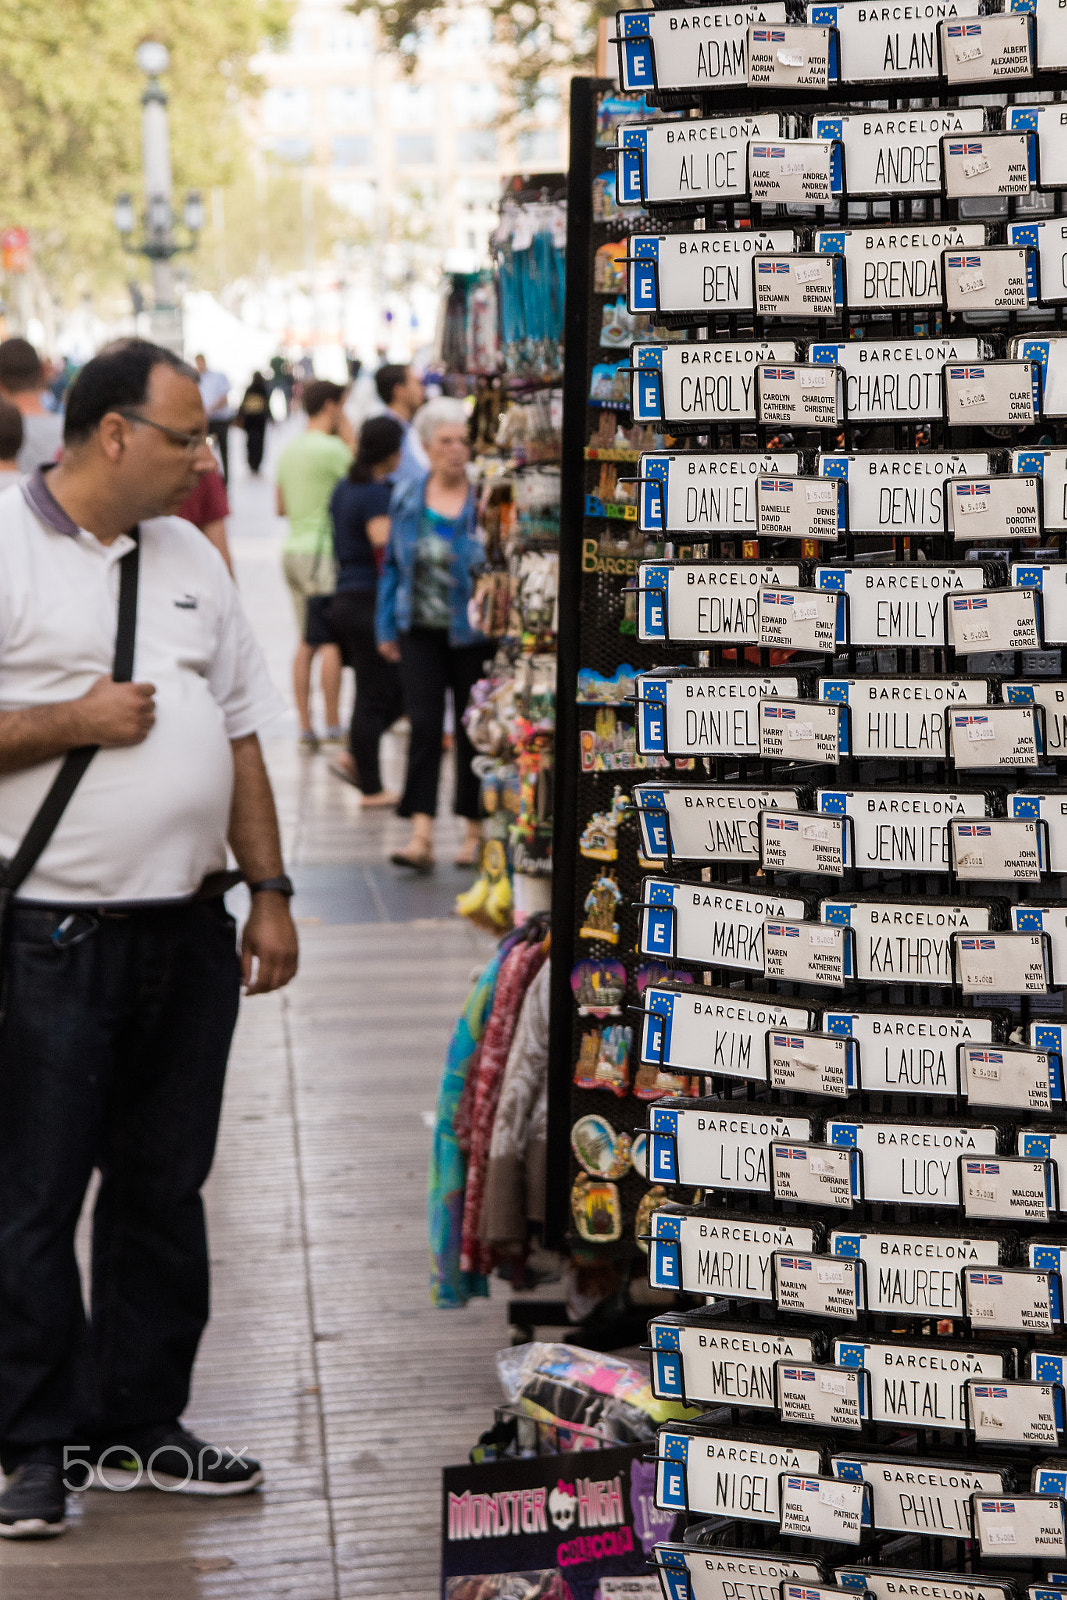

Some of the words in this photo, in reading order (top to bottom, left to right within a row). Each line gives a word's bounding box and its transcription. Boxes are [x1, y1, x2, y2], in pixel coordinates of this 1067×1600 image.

[858, 4, 958, 22] BARCELONA
[669, 12, 767, 30] BARCELONA
[883, 32, 934, 71] ALAN
[1003, 45, 1027, 54] ALBERT
[697, 39, 746, 78] ADAM
[751, 54, 773, 62] AARON
[807, 57, 826, 65] AITOR
[991, 56, 1028, 65] ALEXANDER
[634, 56, 646, 76] E
[751, 64, 775, 73] ADRIAN
[809, 66, 826, 74] ALAN
[993, 66, 1029, 75] ALEXANDRA
[751, 74, 770, 82] ADAM
[797, 76, 826, 84] ALASTAIR
[863, 118, 963, 135] BARCELONA
[667, 124, 761, 143] BARCELONA
[875, 145, 941, 184] ANDRE
[1008, 164, 1027, 172] ANITA
[679, 150, 738, 190] ALICE
[997, 184, 1028, 192] ANTHONY
[679, 239, 775, 254] BARCELONA
[865, 234, 965, 249] BARCELONA
[703, 265, 739, 302] BEN
[864, 260, 942, 299] BRENDA
[1008, 278, 1024, 286] CARL
[758, 284, 771, 292] BEN
[805, 285, 832, 293] BEVERLY
[1004, 287, 1025, 296] CAROL
[758, 294, 790, 302] BENJAMIN
[802, 295, 832, 303] BRENDAN
[994, 297, 1025, 306] CAROLINE
[759, 304, 777, 312] BETTY
[813, 305, 833, 313] BRIAN
[681, 350, 776, 364] BARCELONA
[859, 347, 958, 362] BARCELONA
[645, 387, 656, 407] E
[680, 375, 756, 412] CAROLY
[763, 393, 790, 402] CAROLYN
[801, 395, 835, 404] CHARLOTTE
[763, 403, 796, 412] CATHERINE
[804, 405, 835, 414] CHRISTINE
[763, 412, 791, 421] CHARLES
[814, 415, 836, 424] CLAIRE
[688, 461, 779, 475] BARCELONA
[869, 462, 967, 475] BARCELONA
[1025, 479, 1034, 487] 10
[686, 486, 755, 523] DANIEL
[761, 505, 790, 514] DANIELLE
[879, 487, 942, 524] DENIS
[816, 508, 836, 516] DENIS
[1016, 506, 1036, 514] DONA
[761, 514, 780, 522] DAVID
[813, 517, 836, 525] DENISE
[1005, 516, 1037, 524] DOROTHY
[761, 524, 792, 532] DEBORAH
[808, 526, 836, 536] DOMINIC
[1010, 526, 1037, 534] DOREEN
[687, 572, 780, 585] BARCELONA
[865, 576, 964, 589] BARCELONA
[876, 601, 939, 638] EMILY
[686, 685, 778, 698] BARCELONA
[869, 687, 967, 700] BARCELONA
[650, 721, 661, 741] E
[686, 710, 757, 746] DANIEL
[763, 728, 784, 737] HARRY
[763, 737, 783, 746] HELEN
[814, 732, 836, 742] HILARY
[1017, 736, 1034, 744] JACK
[763, 747, 784, 755] HENRY
[817, 743, 836, 751] HOLLY
[1012, 746, 1034, 754] JACKIE
[999, 756, 1036, 764] JACQUELINE
[684, 796, 779, 808] BARCELONA
[867, 800, 966, 814] BARCELONA
[705, 820, 760, 853] JAMES
[692, 893, 786, 917] BARCELONA
[870, 910, 969, 927] BARCELONA
[654, 923, 665, 943] E
[712, 921, 762, 962] MARK
[1030, 937, 1039, 945] 18
[767, 948, 788, 958] KAREN
[813, 953, 841, 963] KATHRYN
[767, 957, 783, 966] KATE
[767, 967, 785, 976] KATIE
[808, 962, 842, 972] KATHERINE
[1029, 963, 1042, 971] KAY
[815, 972, 842, 982] KATRINA
[1024, 973, 1043, 981] KEITH
[1025, 982, 1045, 990] KELLY
[694, 1002, 788, 1026] BARCELONA
[873, 1021, 972, 1038] BARCELONA
[714, 1030, 752, 1069] KIM
[885, 1047, 947, 1086] LAURA
[698, 1118, 791, 1137] BARCELONA
[877, 1132, 976, 1149] BARCELONA
[838, 1152, 847, 1160] 21
[720, 1144, 767, 1183] LISA
[819, 1175, 849, 1185] LORRAINE
[902, 1158, 951, 1197] LUCY
[777, 1180, 791, 1188] LISA
[777, 1189, 799, 1198] LORNA
[1012, 1189, 1044, 1198] MALCOLM
[834, 1195, 850, 1204] LUCY
[1010, 1199, 1044, 1208] MARGARET
[1024, 1209, 1046, 1218] MARIE
[699, 1224, 794, 1246] BARCELONA
[880, 1242, 979, 1260] BARCELONA
[662, 1256, 673, 1276] E
[698, 1249, 770, 1291] MARILY
[699, 1335, 794, 1357] BARCELONA
[885, 1353, 983, 1374] BARCELONA
[711, 1360, 773, 1401] MEGAN
[847, 1373, 856, 1382] 25
[783, 1392, 806, 1401] MEGAN
[784, 1401, 812, 1411] MICHAEL
[841, 1398, 857, 1407] MIKE
[785, 1410, 815, 1421] MICHELLE
[833, 1406, 858, 1416] NATALIE
[830, 1415, 859, 1426] NATASHA
[1038, 1413, 1053, 1422] NEIL
[1030, 1422, 1054, 1431] NICOLA
[1023, 1432, 1055, 1441] NICHOLAS
[707, 1445, 800, 1469] BARCELONA
[883, 1470, 983, 1490] BARCELONA
[669, 1475, 681, 1496] E
[716, 1471, 775, 1514] NIGEL
[448, 1487, 549, 1541] MONSTER
[576, 1476, 625, 1528] HIGH
[785, 1502, 803, 1512] NIGEL
[785, 1512, 810, 1523] PAMELA
[833, 1509, 860, 1520] PATRICK
[784, 1521, 812, 1533] PATRICIA
[842, 1520, 859, 1530] PAUL
[1040, 1527, 1062, 1535] PAULA
[1035, 1536, 1063, 1545] PAULINE
[705, 1559, 801, 1578] BARCELONA
[886, 1582, 986, 1600] BARCELONA
